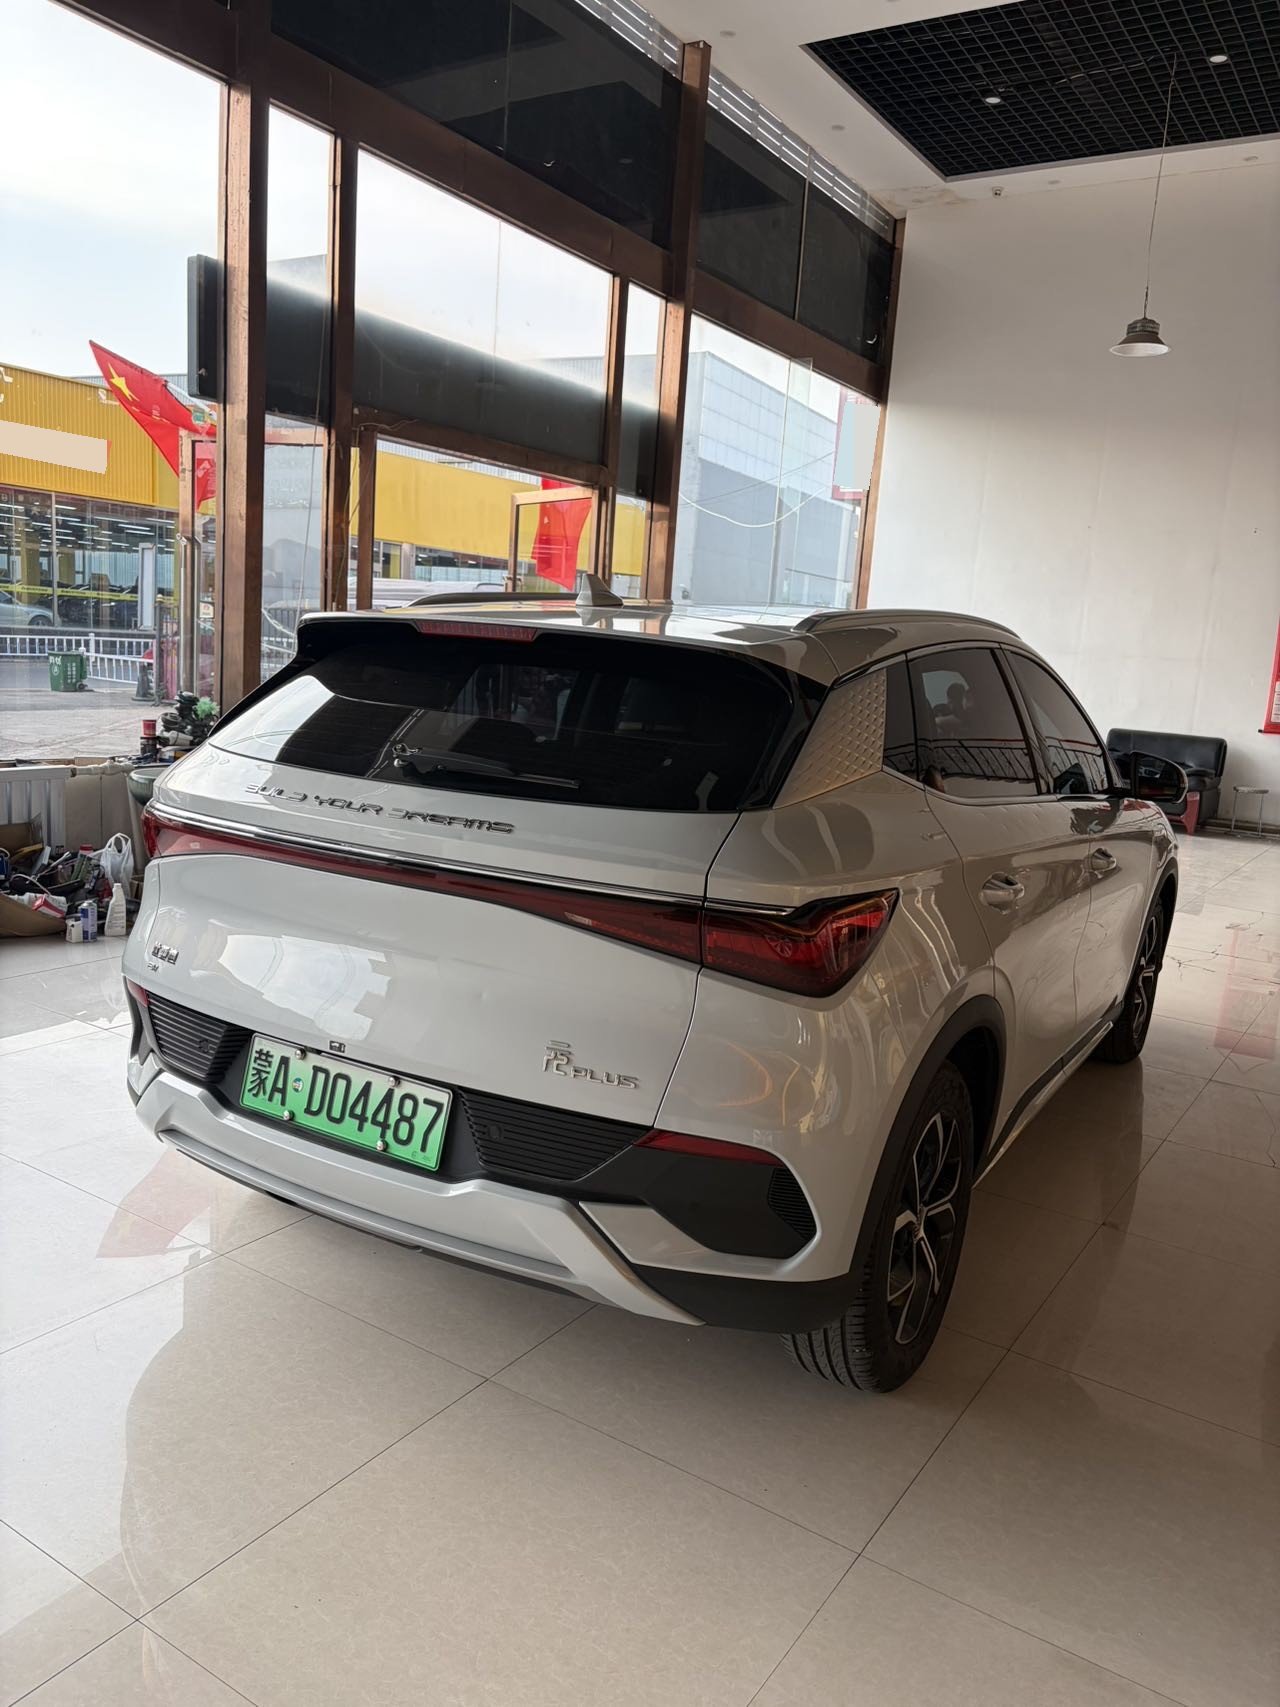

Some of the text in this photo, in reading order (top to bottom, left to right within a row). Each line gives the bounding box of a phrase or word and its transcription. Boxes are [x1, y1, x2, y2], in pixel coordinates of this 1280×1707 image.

[313, 795, 383, 815] YOUR
[387, 807, 515, 833] DREAMS
[570, 1066, 640, 1089] PLUS
